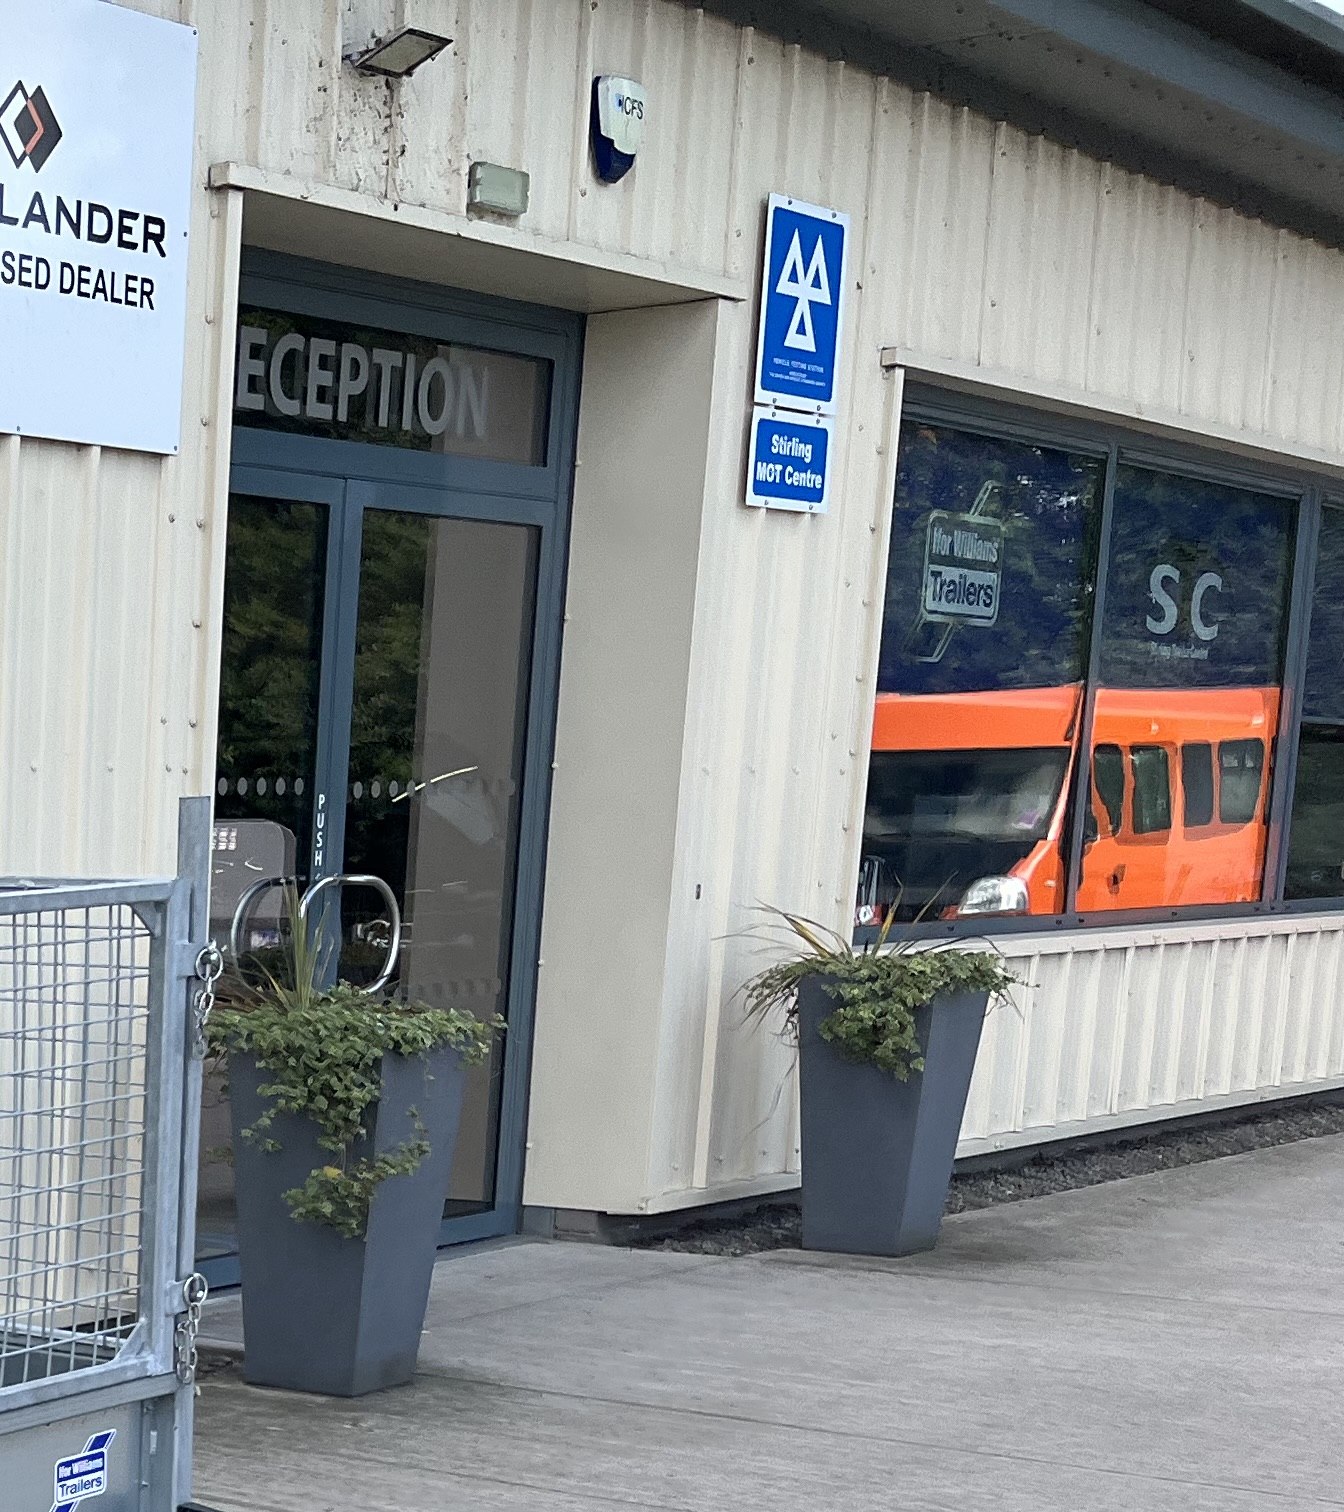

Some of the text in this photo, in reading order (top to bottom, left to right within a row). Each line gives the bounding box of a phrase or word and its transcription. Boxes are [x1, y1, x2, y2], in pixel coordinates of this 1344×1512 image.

[59, 261, 155, 310] DEALER
[235, 325, 490, 438] ECEPTION
[771, 434, 813, 464] Stirling
[756, 461, 823, 489] MOT Centre
[930, 571, 994, 608] Trailers
[314, 793, 326, 867] PUSH
[58, 1476, 102, 1498] Trailers
